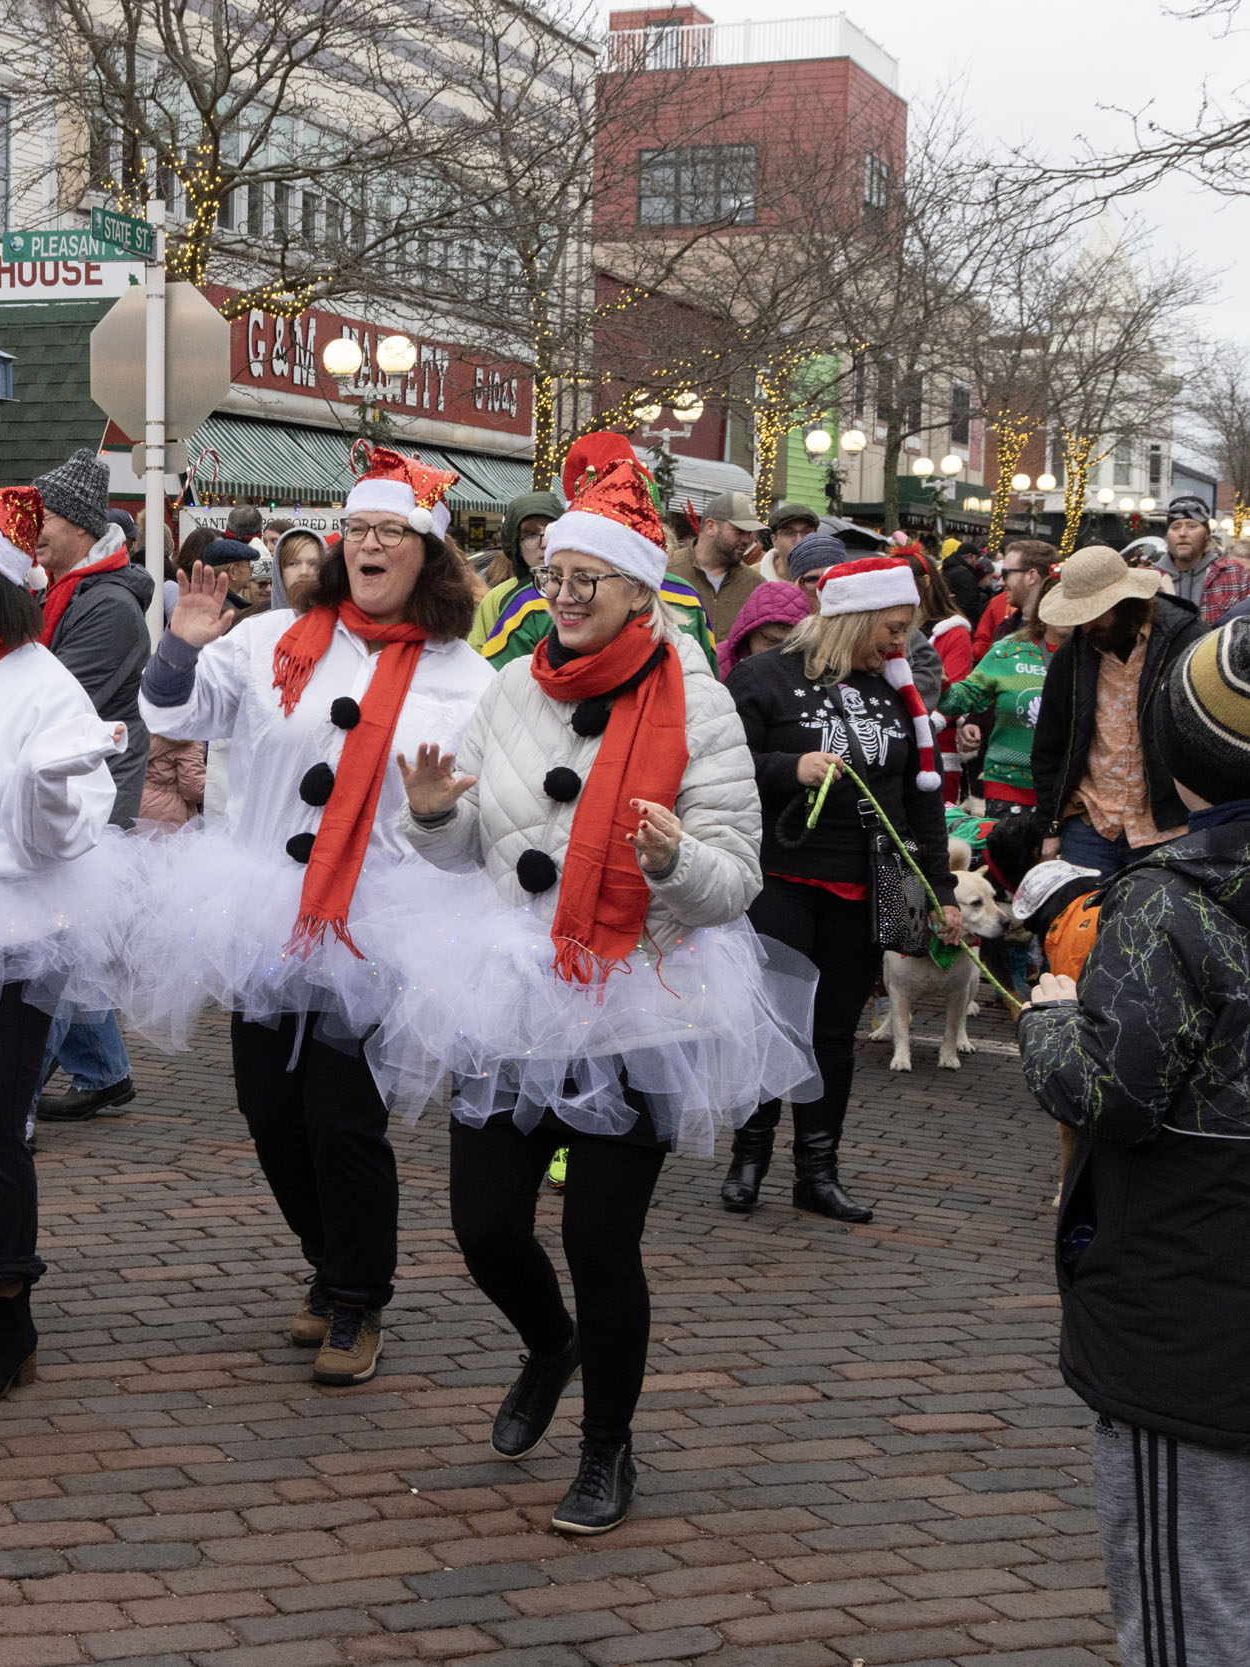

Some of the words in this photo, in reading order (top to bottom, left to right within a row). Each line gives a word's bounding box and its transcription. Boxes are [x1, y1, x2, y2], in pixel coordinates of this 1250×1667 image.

[104, 215, 132, 246] STATE
[135, 225, 151, 252] ST.
[195, 517, 226, 530] SANT
